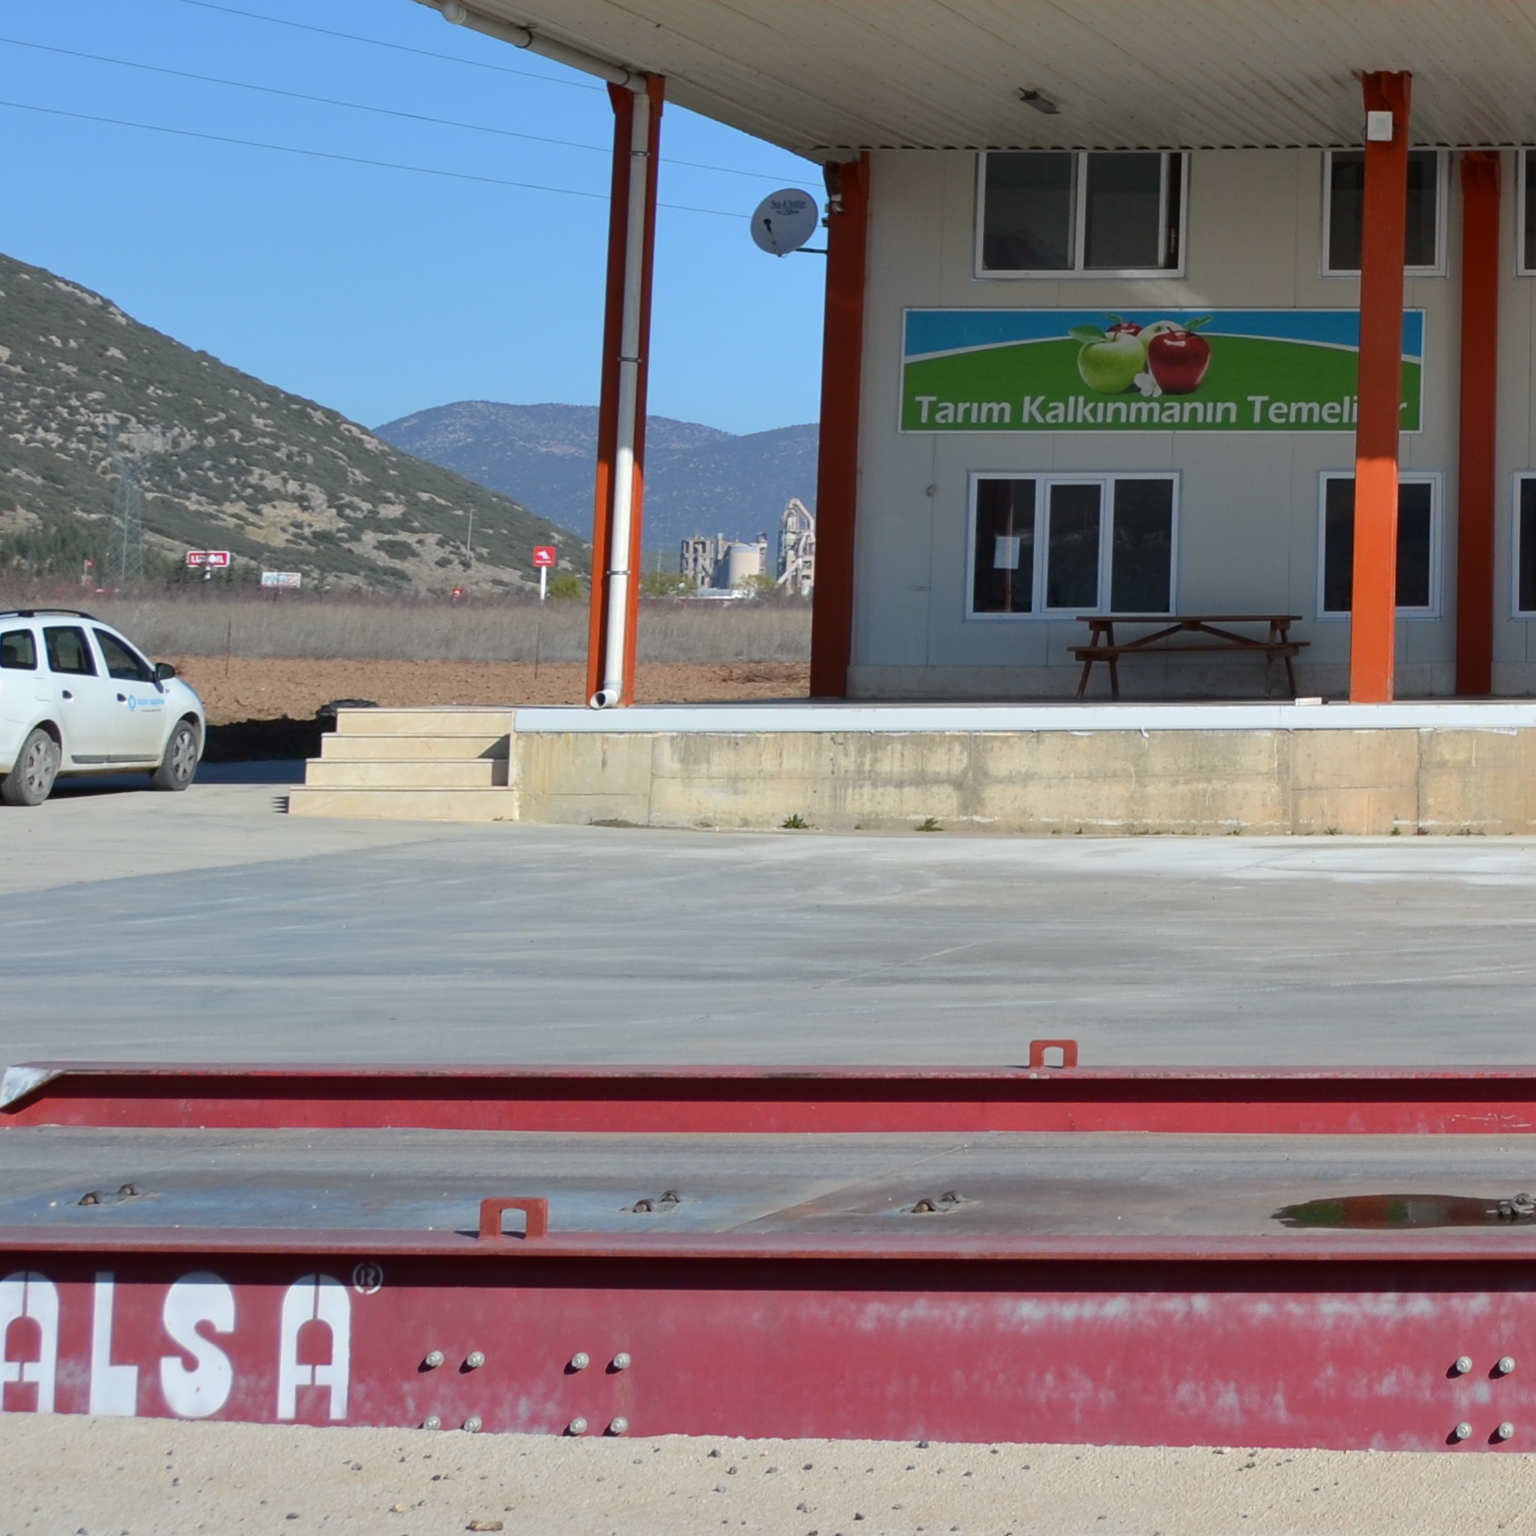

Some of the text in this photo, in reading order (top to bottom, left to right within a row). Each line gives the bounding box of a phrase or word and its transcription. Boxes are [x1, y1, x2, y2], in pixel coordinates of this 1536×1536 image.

[914, 395, 1408, 424] Tarım Kalkınmanın Temeli
